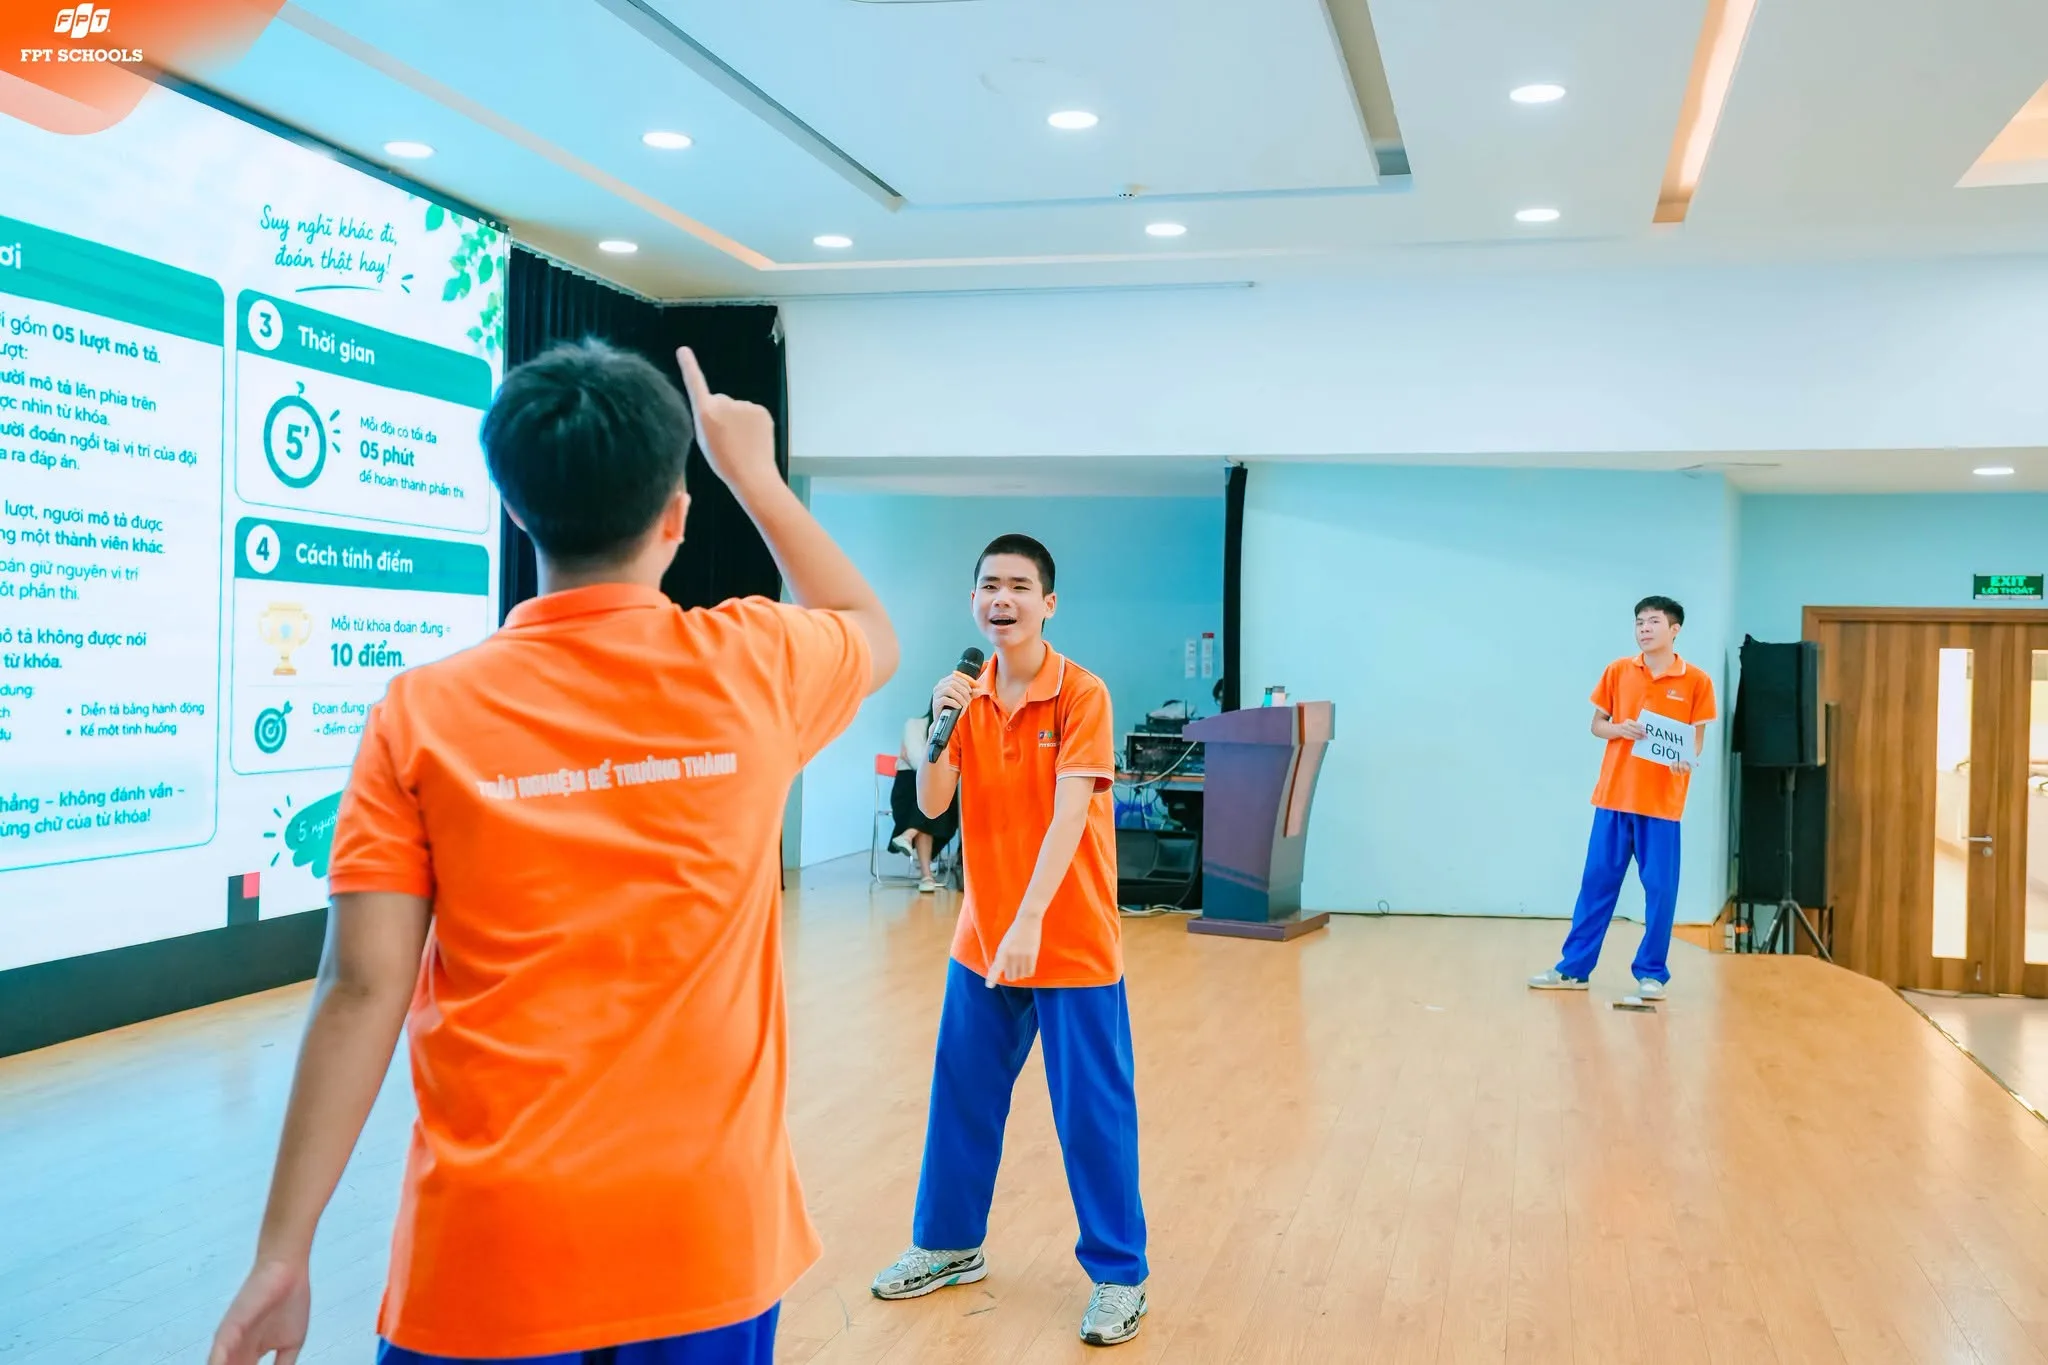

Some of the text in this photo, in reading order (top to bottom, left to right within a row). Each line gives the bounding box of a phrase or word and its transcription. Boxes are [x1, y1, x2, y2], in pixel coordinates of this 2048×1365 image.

[260, 204, 290, 241] Suy
[297, 213, 332, 244] nghĩ
[339, 216, 374, 241] khác
[274, 246, 392, 284] đoán thật hay!
[259, 312, 273, 338] 3
[53, 323, 75, 343] 05
[80, 330, 110, 354] lượt
[115, 341, 139, 358] mô
[298, 325, 375, 366] Thời gian
[0, 369, 25, 386] ười
[30, 373, 52, 390] mô
[57, 379, 72, 395] tả
[76, 382, 96, 400] lên
[132, 396, 157, 412] trên
[0, 420, 25, 437] ười
[29, 425, 66, 444] đoán
[179, 450, 197, 468] đội
[425, 431, 437, 445] đa
[12, 450, 25, 462] ra
[30, 449, 57, 470] đáp
[360, 440, 415, 467] 05 phút
[5, 500, 163, 533] lượt, người mô tả được
[21, 528, 50, 547] một
[55, 530, 97, 548] thành
[101, 535, 129, 551] viên
[256, 537, 270, 561] 4
[295, 541, 413, 574] Cách tính điểm
[57, 563, 107, 581] nguyên
[1990, 575, 2027, 587] EXIT
[18, 627, 33, 644] tả
[37, 628, 84, 649] không
[88, 630, 122, 649] được
[126, 632, 147, 646] nói
[4, 653, 20, 668] từ
[330, 642, 353, 667] 10
[1645, 723, 1684, 746] RANH
[59, 790, 106, 808] không
[110, 785, 145, 803] đánh
[66, 813, 92, 831] của
[114, 807, 151, 826] khóa!
[298, 820, 307, 842] 5
